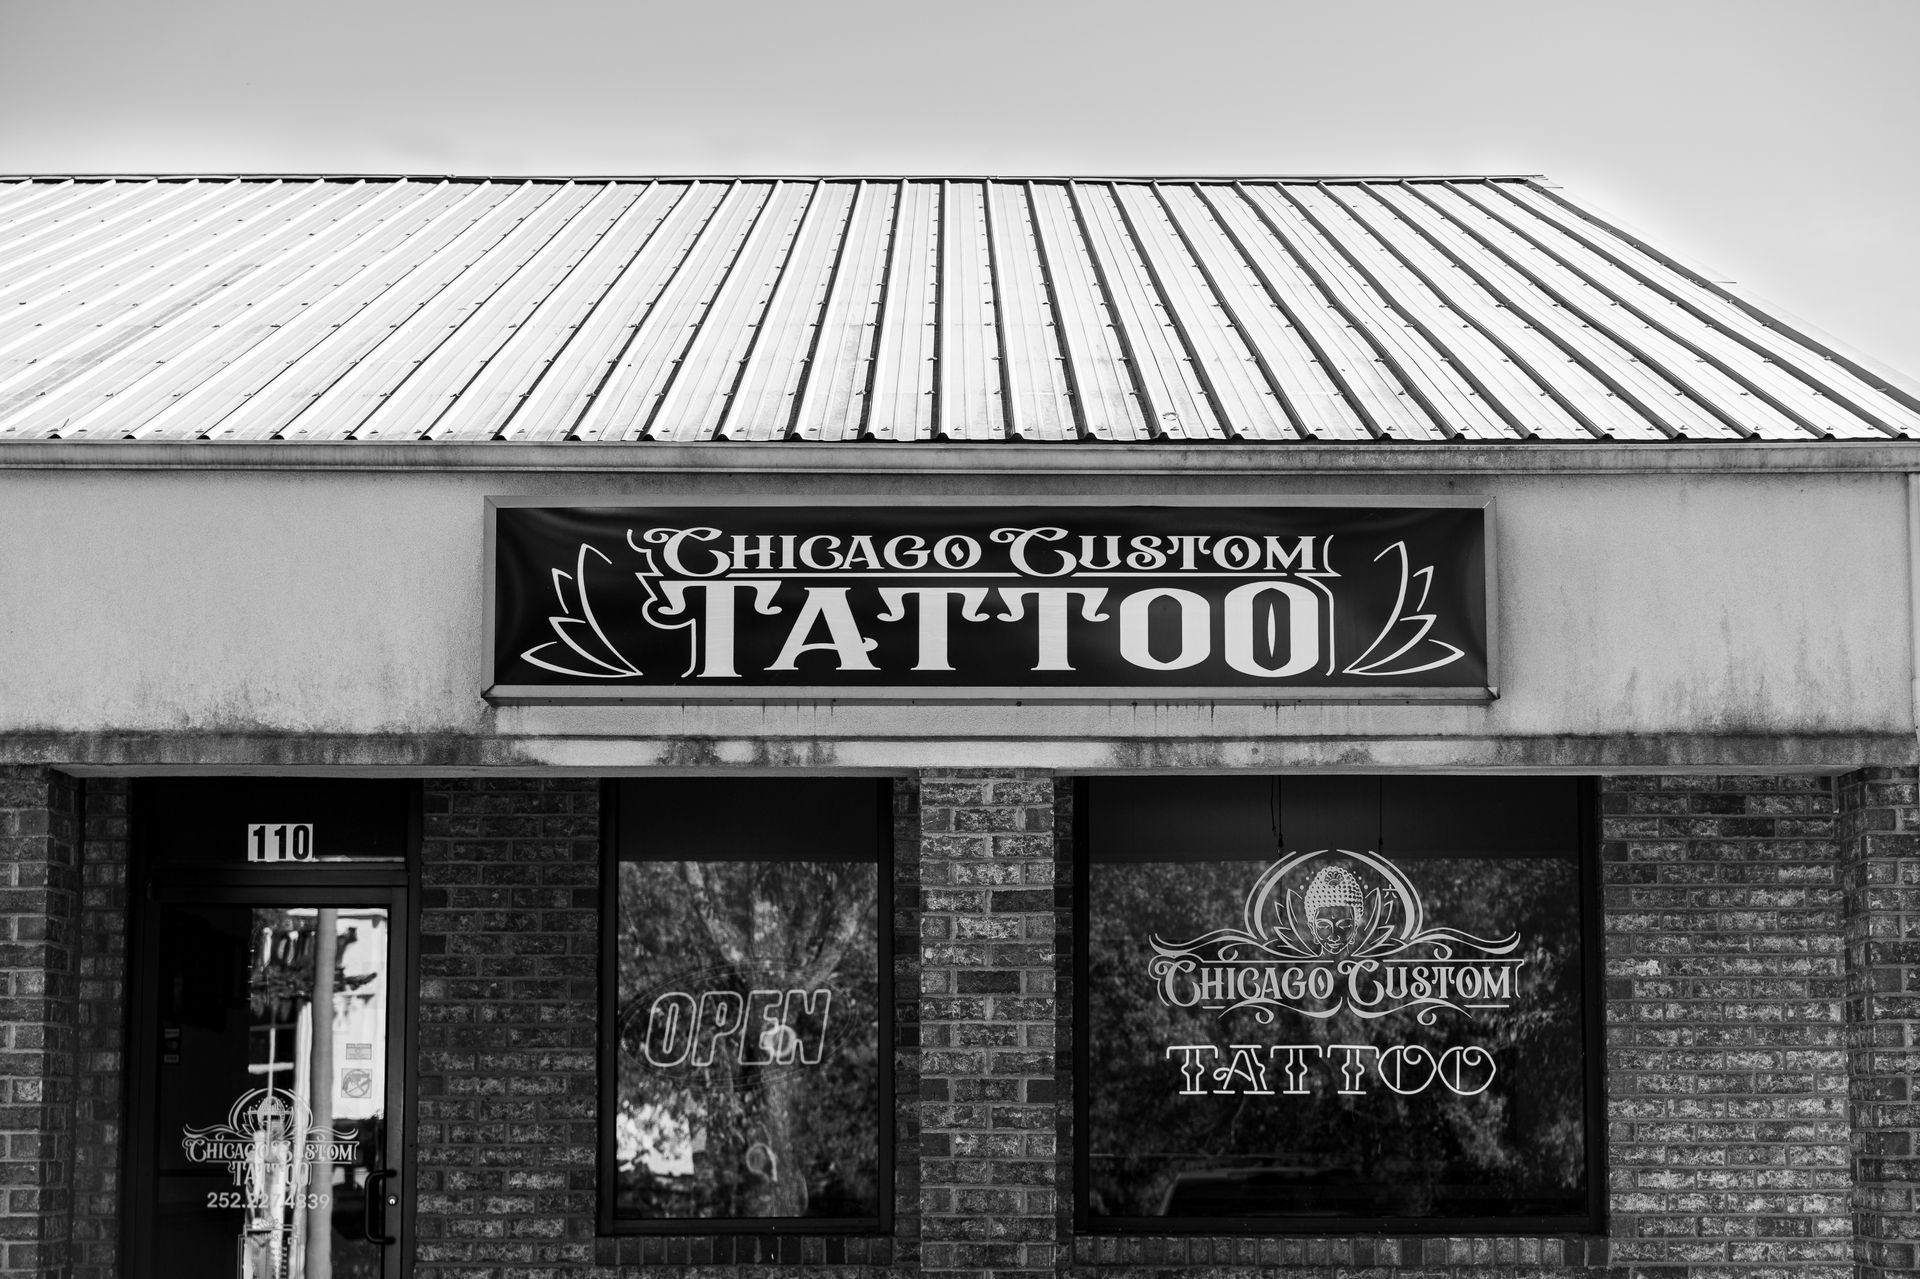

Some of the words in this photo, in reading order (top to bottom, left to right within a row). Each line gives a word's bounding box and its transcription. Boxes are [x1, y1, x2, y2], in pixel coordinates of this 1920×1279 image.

[643, 526, 983, 578] CHICAGO
[989, 526, 1317, 578] CUSTOM
[657, 579, 1320, 679] TATTOO
[252, 824, 310, 861] 110
[1153, 959, 1334, 1007] CHICAGO
[1337, 959, 1511, 1007] CUSTOM
[645, 989, 832, 1068] OPEN
[1166, 1044, 1497, 1096] TATTOO
